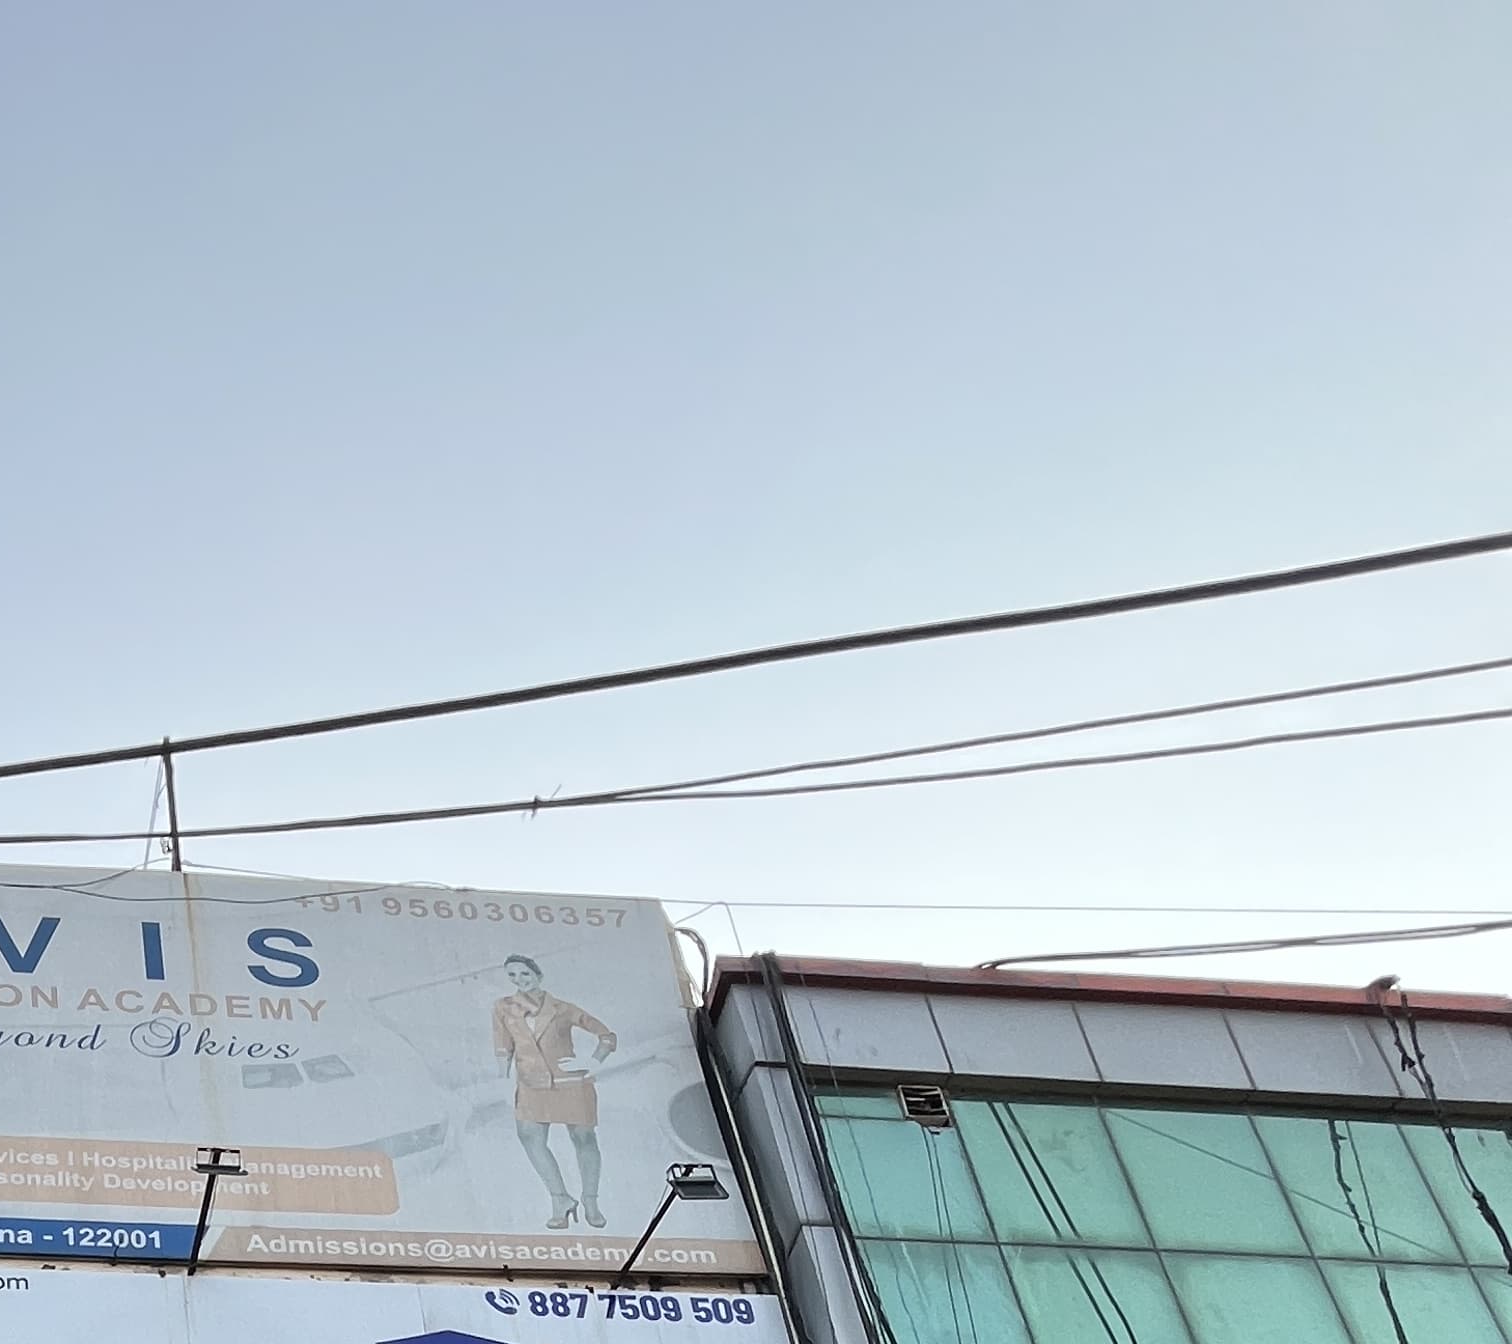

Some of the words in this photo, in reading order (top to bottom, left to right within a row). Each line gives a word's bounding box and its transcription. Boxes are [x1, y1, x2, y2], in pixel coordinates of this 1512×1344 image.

[380, 897, 628, 929] 9560306357
[77, 987, 328, 1022] ACADEMY
[129, 1016, 301, 1059] Skies
[63, 1227, 163, 1250] 122001
[527, 1290, 588, 1319] 887
[597, 1293, 683, 1323] 7509
[692, 1297, 756, 1325] 509
